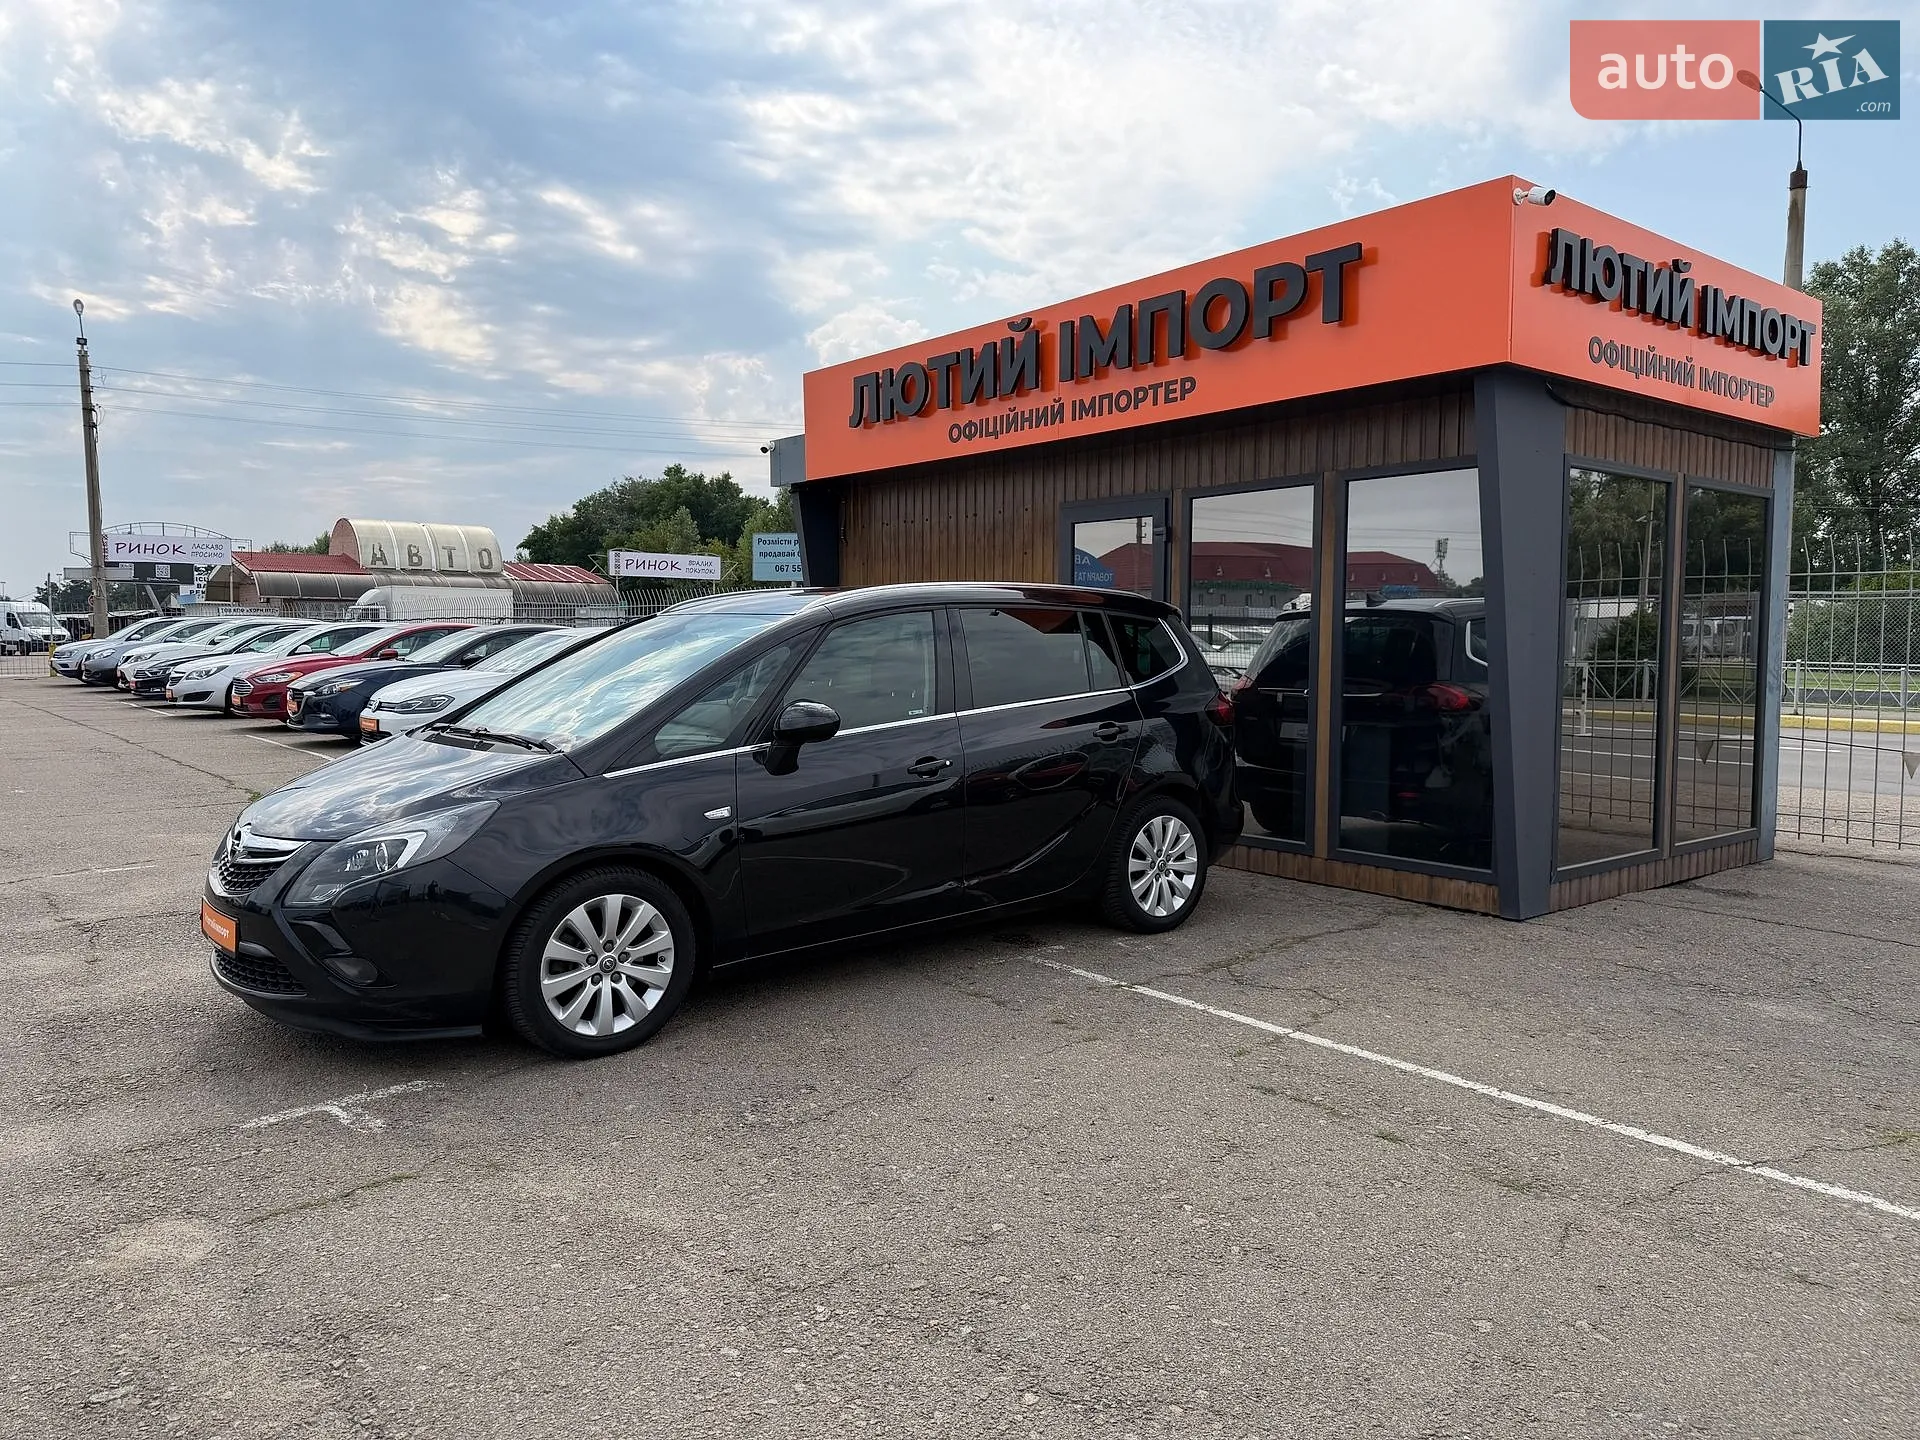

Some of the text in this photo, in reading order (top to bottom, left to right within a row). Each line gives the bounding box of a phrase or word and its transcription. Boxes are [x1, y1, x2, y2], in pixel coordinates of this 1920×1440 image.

[1547, 228, 1816, 366] ЛЮТИЙ ІМПОРТ
[849, 242, 1362, 429] ЛЮТИЙ ІМПОРТ
[1589, 336, 1775, 408] ОФІЦІЙНИЙ ІМПОРТЕР
[948, 376, 1197, 443] ОФІЦІЙНИЙ ІМПОРТЕР
[115, 542, 187, 555] РИНОК
[757, 537, 792, 546] Розмісти
[370, 542, 494, 570] АВТО
[759, 549, 796, 559] продавай
[624, 558, 682, 571] РИНОК
[774, 564, 790, 573] 067
